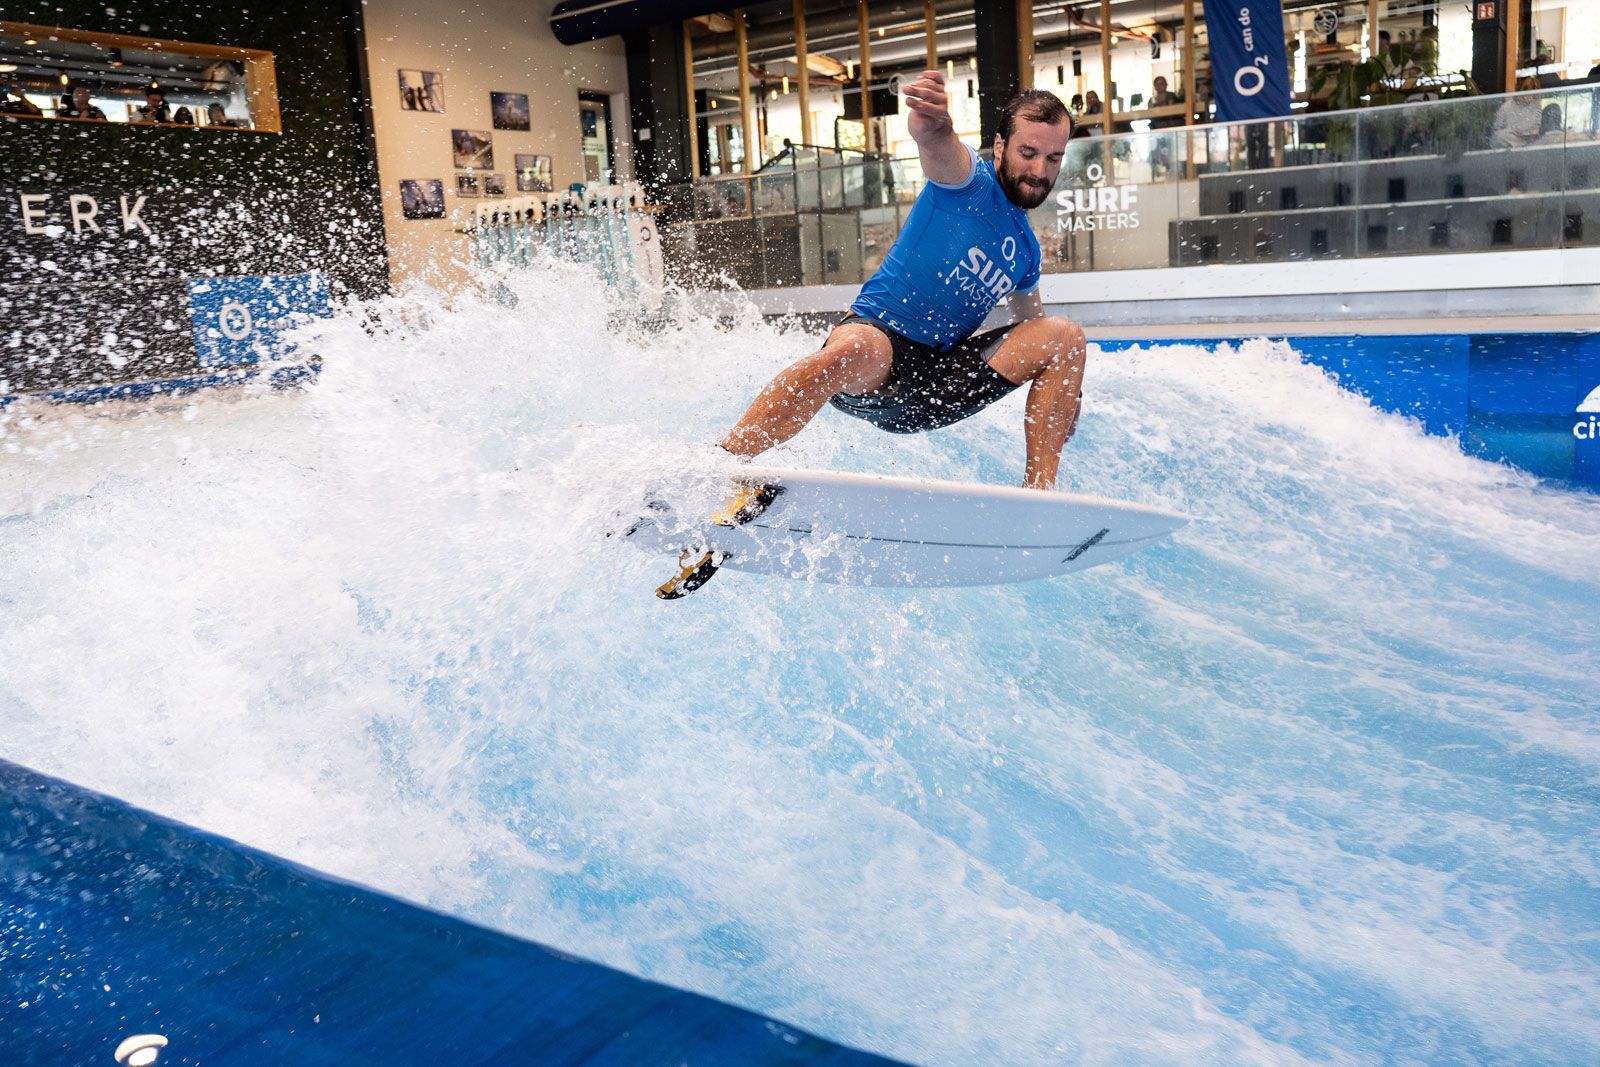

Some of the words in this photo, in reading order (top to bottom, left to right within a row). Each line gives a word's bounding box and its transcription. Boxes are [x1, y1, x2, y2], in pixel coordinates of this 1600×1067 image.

[1238, 7, 1251, 26] do
[1242, 27, 1254, 52] can
[1056, 184, 1138, 216] SURF
[20, 193, 152, 236] ERK
[1056, 210, 1140, 233] MASTERS
[959, 247, 1017, 300] SUR
